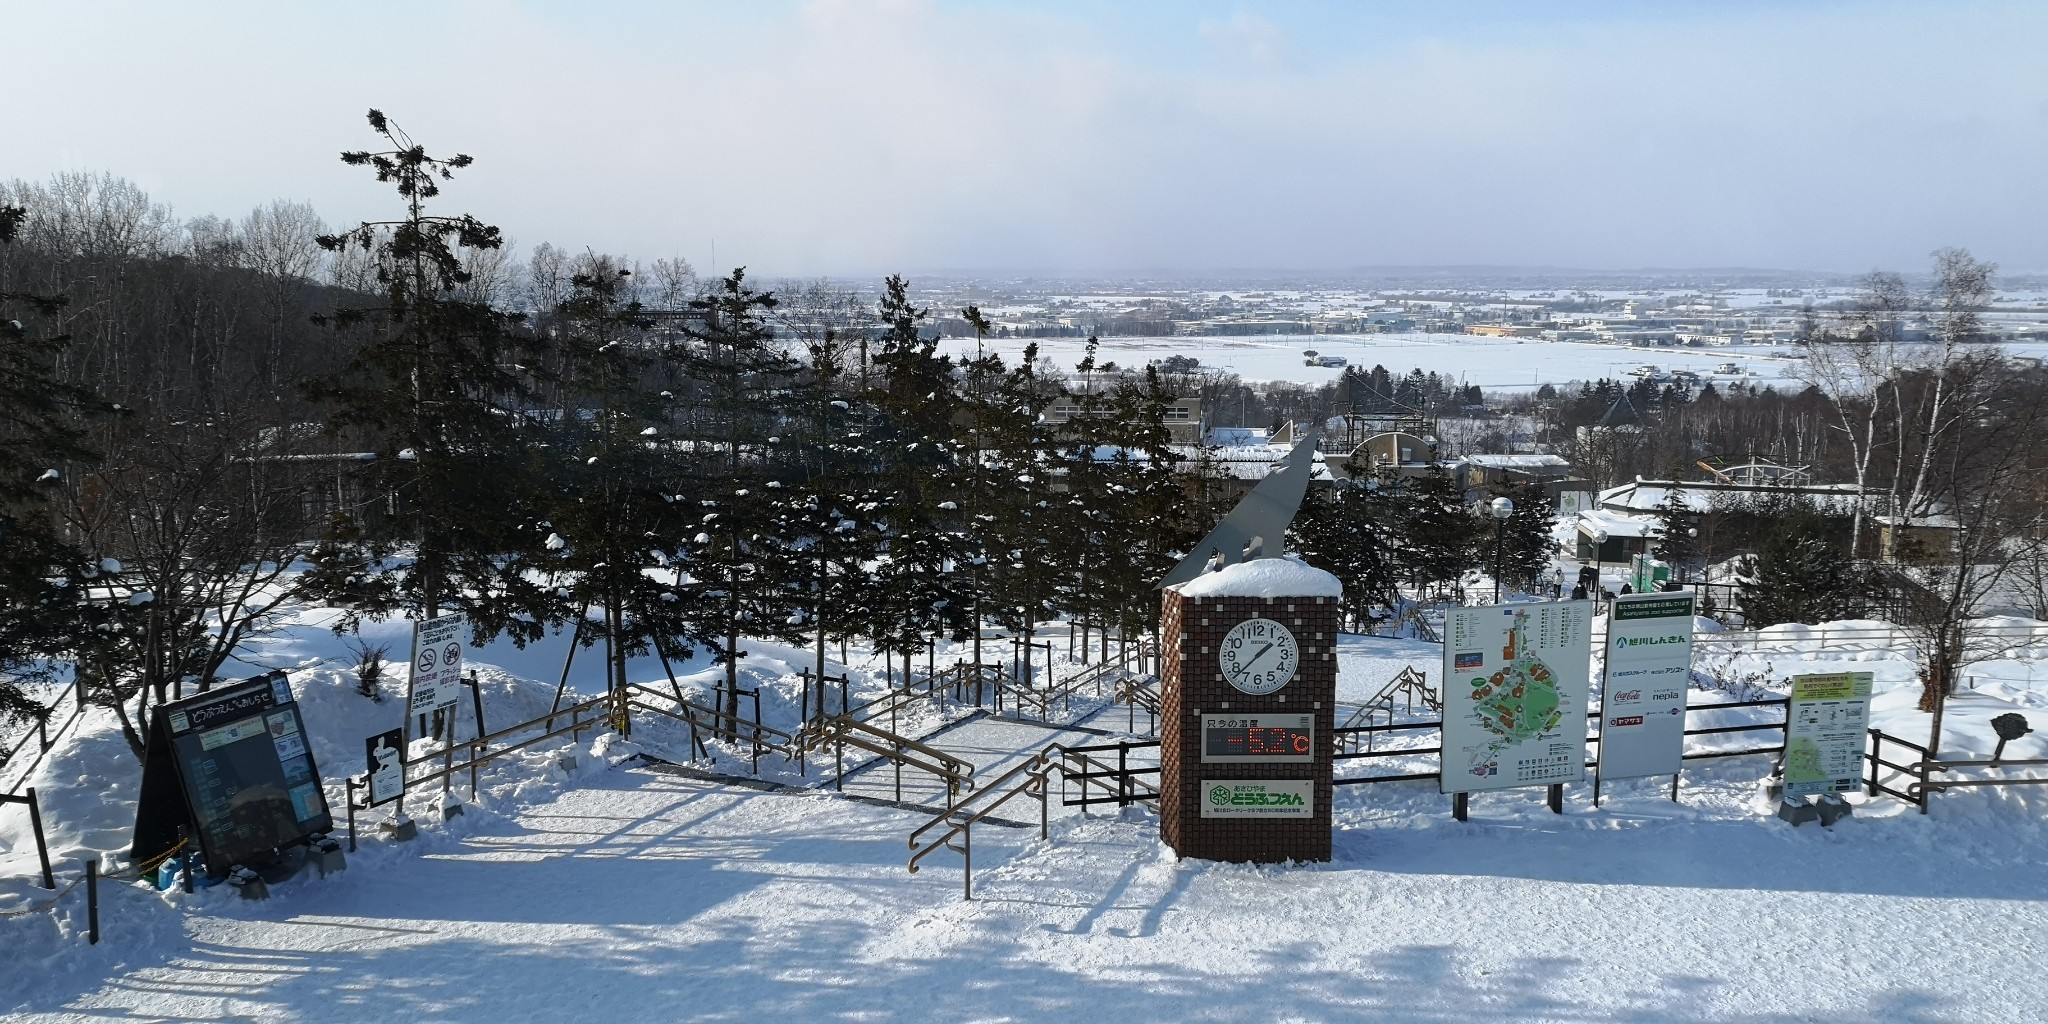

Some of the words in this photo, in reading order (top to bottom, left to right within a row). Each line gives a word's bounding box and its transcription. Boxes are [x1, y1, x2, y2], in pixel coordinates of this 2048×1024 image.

[1242, 628, 1251, 639] 11
[1253, 625, 1265, 636] 12
[1230, 638, 1242, 649] 10
[1277, 636, 1285, 647] 2
[1628, 635, 1686, 646] 旭川しんきん
[1227, 651, 1236, 661] 9
[1280, 649, 1289, 660] 3
[1231, 662, 1240, 673] 8
[1276, 661, 1285, 672] 4
[1242, 672, 1250, 682] 7
[1253, 674, 1262, 685] 6
[1266, 671, 1275, 681] 5
[1653, 691, 1679, 701] nepia
[1207, 719, 1259, 728] 只今の温度
[1230, 793, 1305, 806] どうぶつえん
